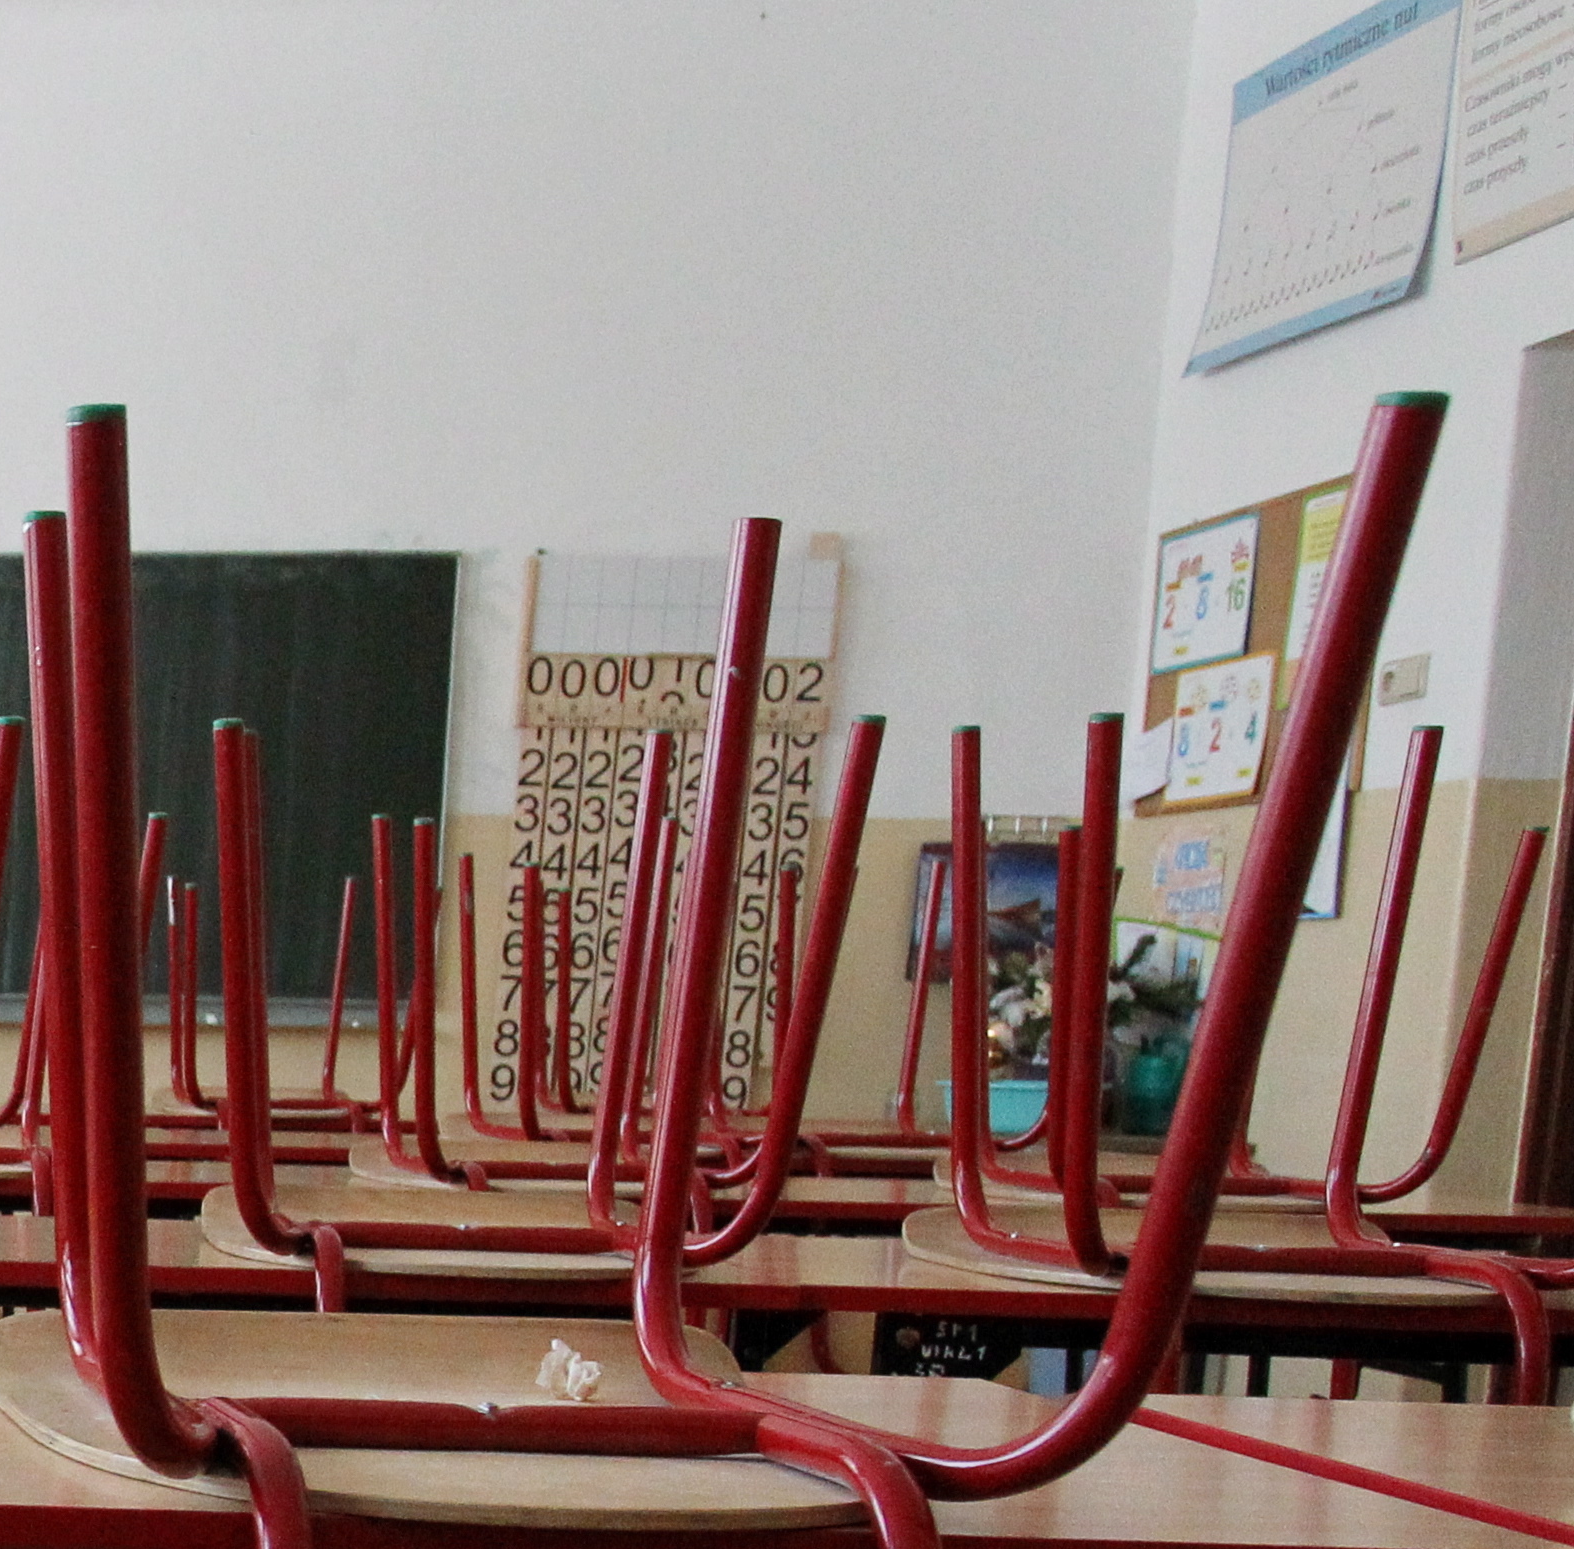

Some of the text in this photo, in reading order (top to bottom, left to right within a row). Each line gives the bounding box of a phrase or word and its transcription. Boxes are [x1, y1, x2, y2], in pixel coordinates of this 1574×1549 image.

[1163, 576, 1247, 630] 2 8 16
[1209, 717, 1222, 754] 2
[1245, 710, 1258, 745] 4
